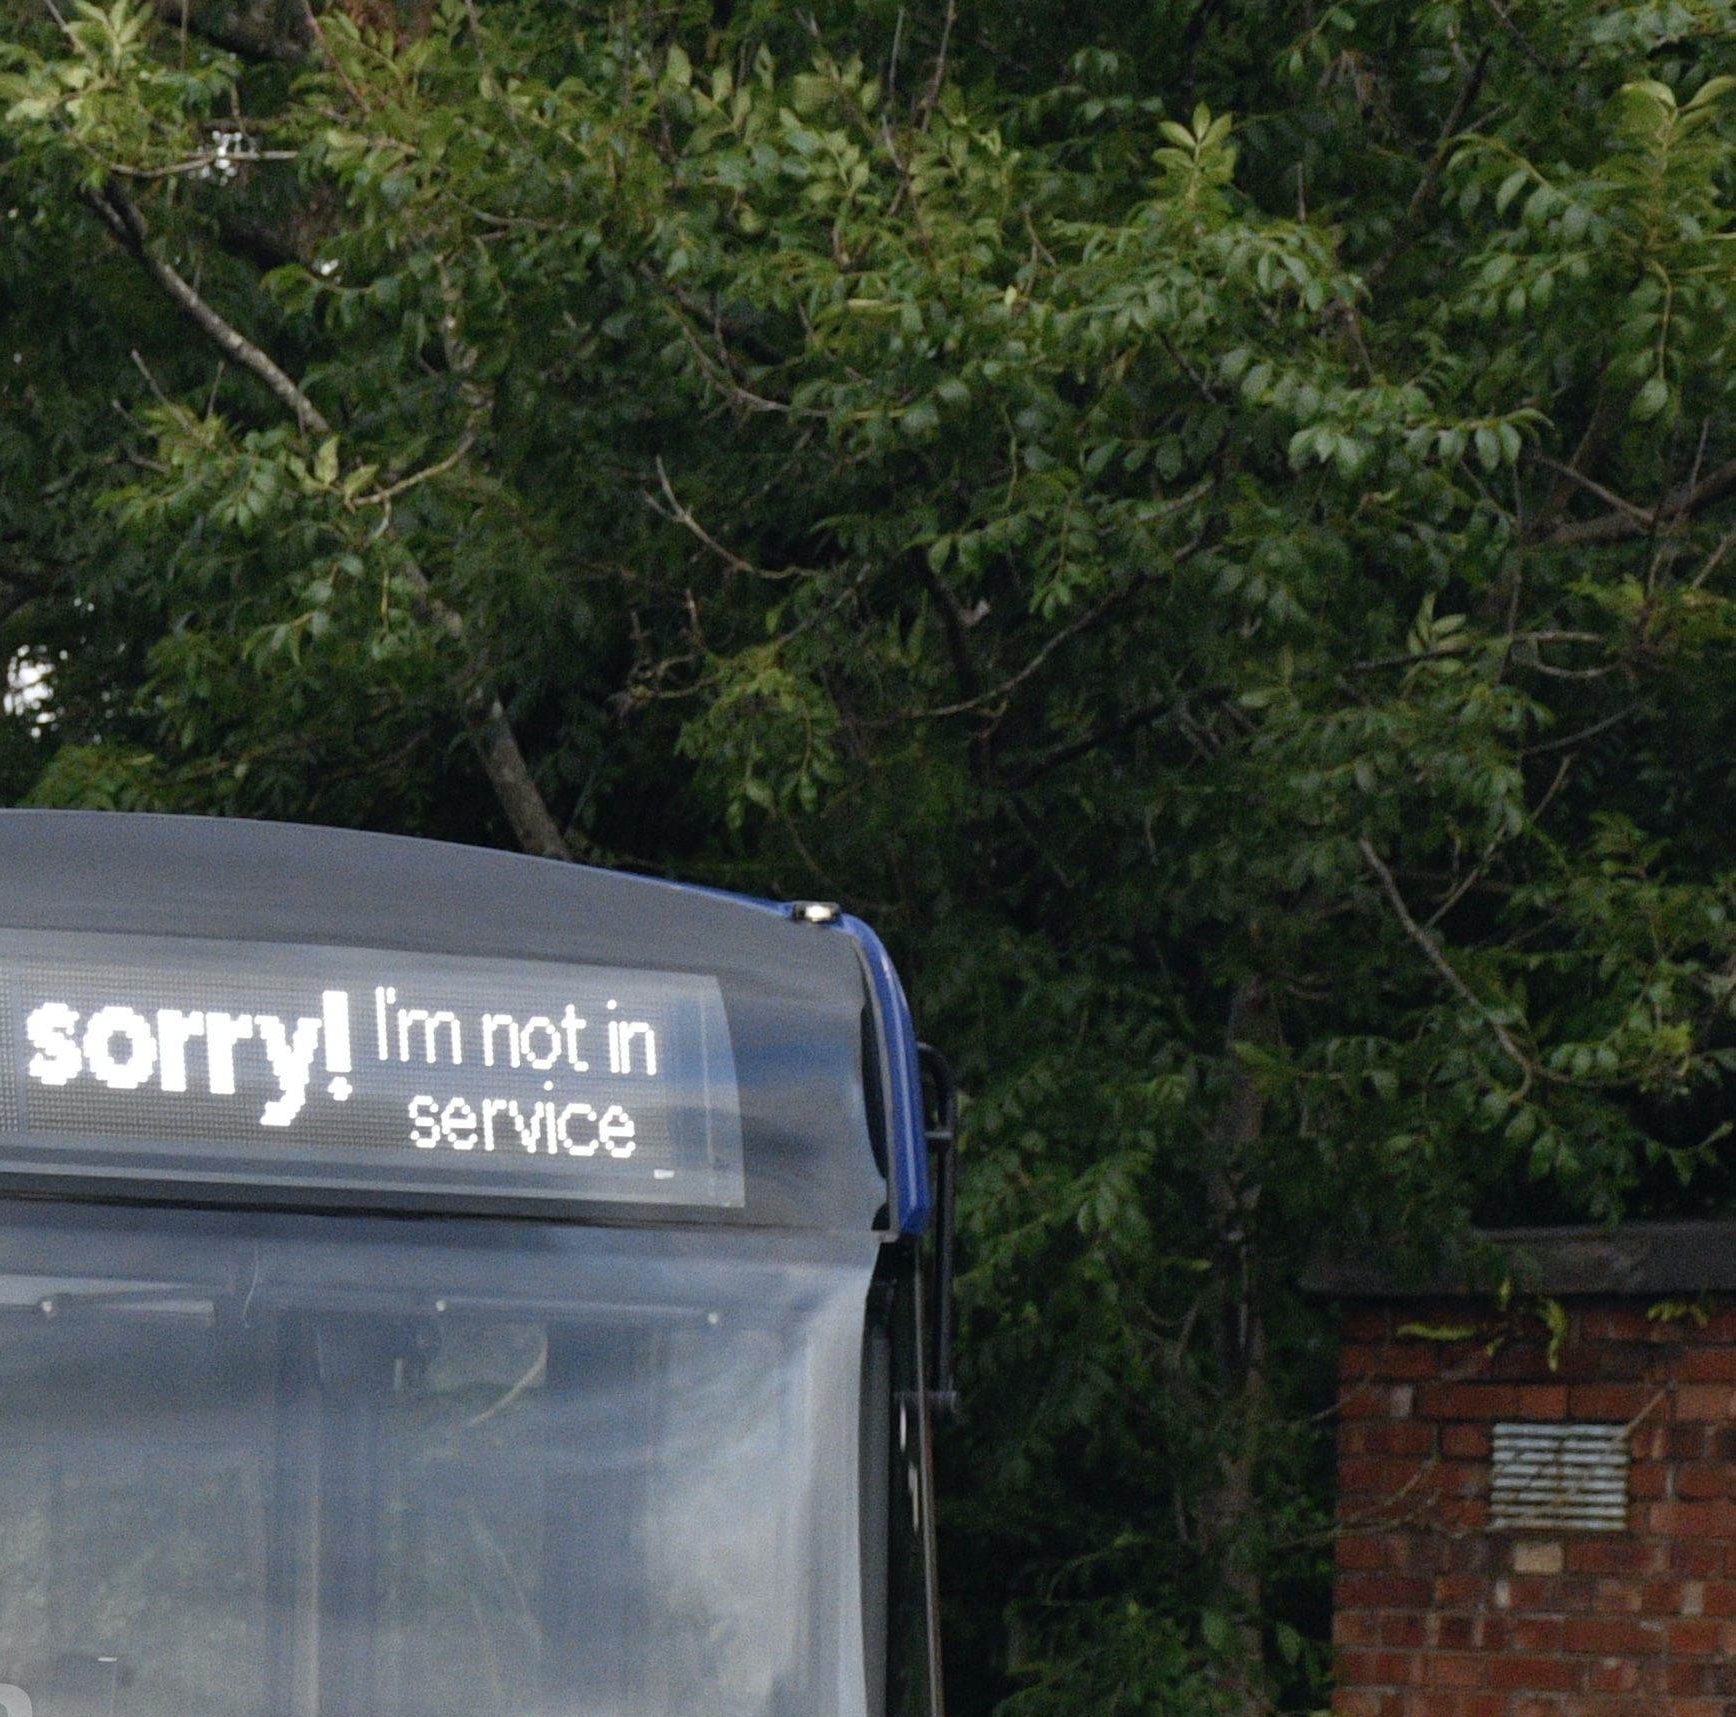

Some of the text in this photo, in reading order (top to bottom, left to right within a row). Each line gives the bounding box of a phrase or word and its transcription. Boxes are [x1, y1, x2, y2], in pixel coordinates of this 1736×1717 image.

[24, 986, 354, 1128] sorry!
[375, 984, 658, 1078] I'm not in
[406, 1078, 637, 1160] service
